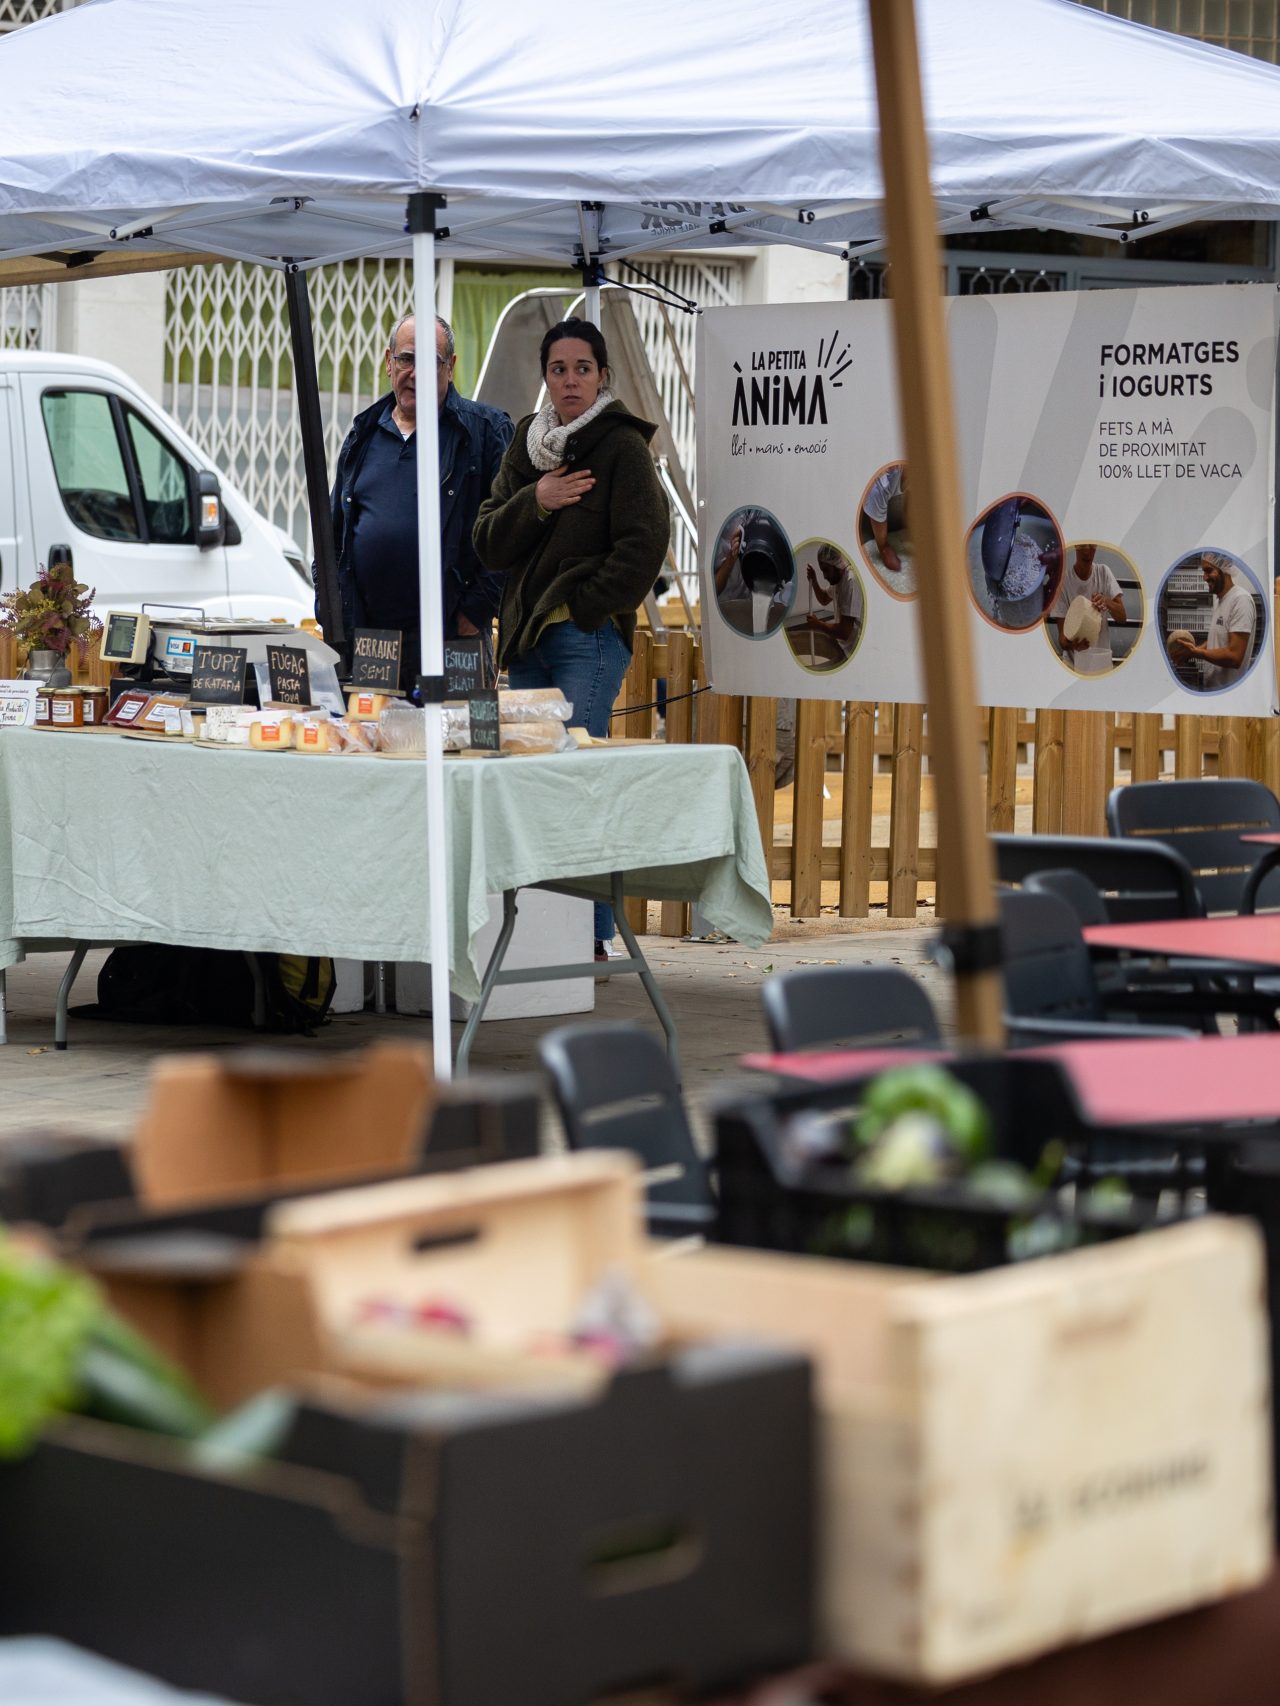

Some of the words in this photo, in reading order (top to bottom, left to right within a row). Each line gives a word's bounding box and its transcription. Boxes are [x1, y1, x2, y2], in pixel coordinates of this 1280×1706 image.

[751, 351, 766, 371] LA
[768, 350, 807, 371] PETITA
[1100, 340, 1240, 367] FORMATGES
[1099, 373, 1105, 398] i
[1112, 373, 1214, 398] IOGURTS
[1099, 421, 1133, 436] FETS
[1137, 421, 1148, 436] A
[1151, 417, 1174, 436] MÀ
[731, 433, 747, 456] llet
[755, 443, 784, 455] mans
[794, 438, 829, 455] emoció
[1099, 443, 1118, 457] DE
[1121, 442, 1207, 457] PROXIMITAT
[1098, 464, 1133, 479] 100%
[1137, 464, 1171, 479] LLET
[1175, 464, 1196, 478] DE
[1199, 463, 1243, 478] VACA
[271, 651, 306, 677] FUGAÇ
[444, 648, 480, 671] ESTUCAT
[359, 664, 391, 681] SEMI
[192, 677, 202, 689] DE
[277, 675, 301, 691] PASTA
[279, 690, 300, 703] TOVA
